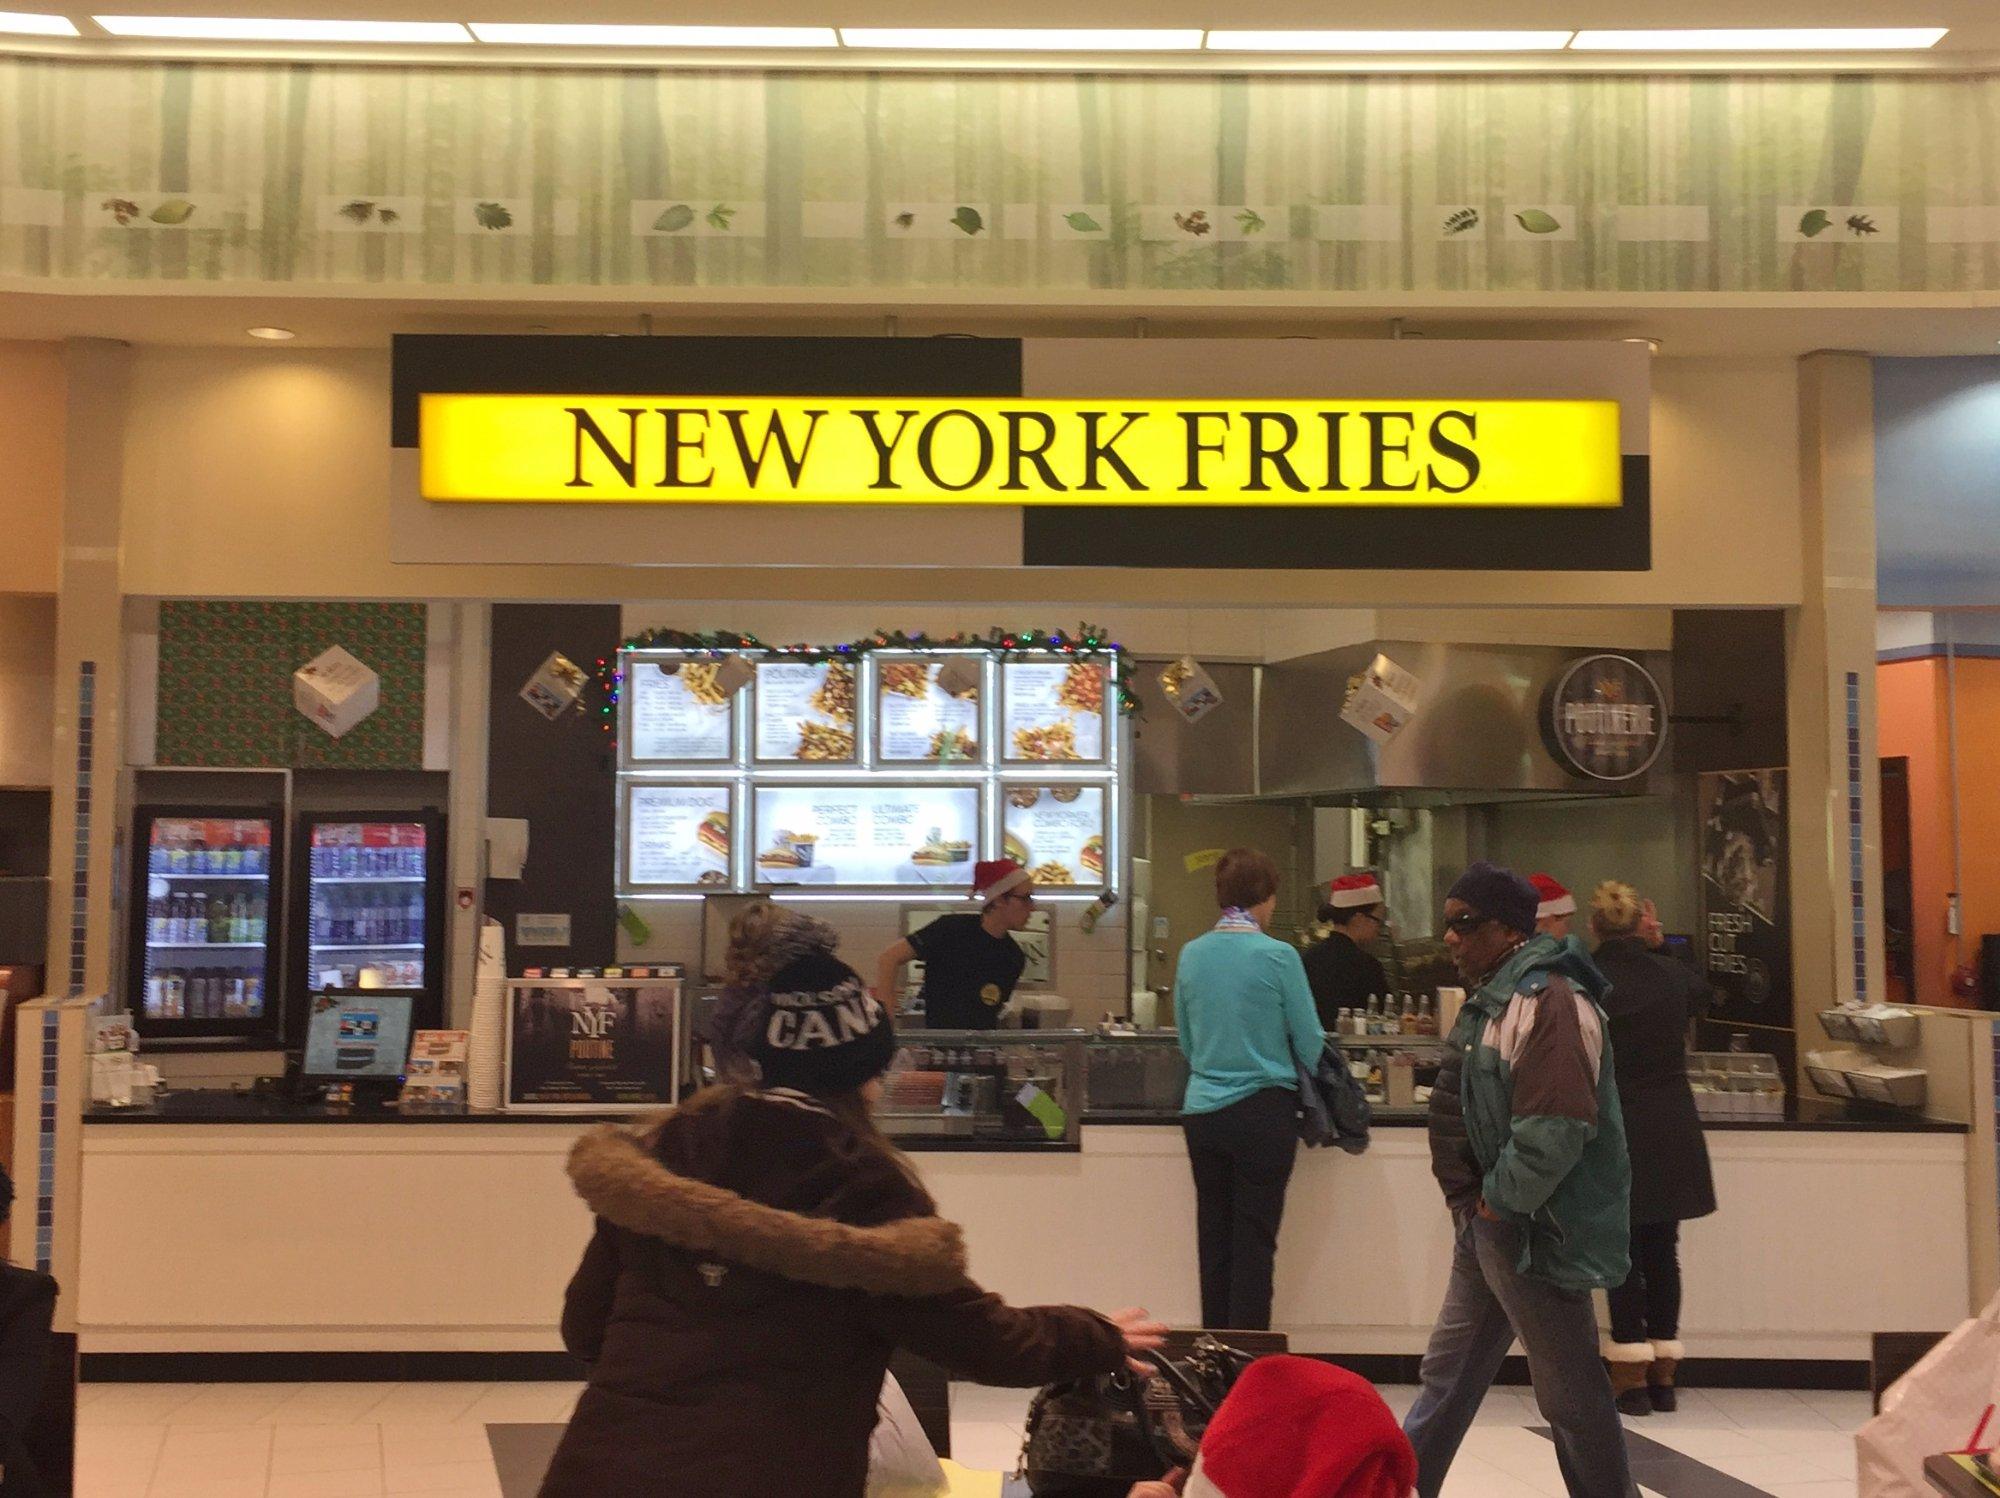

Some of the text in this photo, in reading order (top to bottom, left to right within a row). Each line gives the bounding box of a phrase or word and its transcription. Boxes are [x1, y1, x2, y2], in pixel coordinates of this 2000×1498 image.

[564, 408, 1481, 493] NEW YORK FRIES
[570, 1005, 617, 1038] NYF
